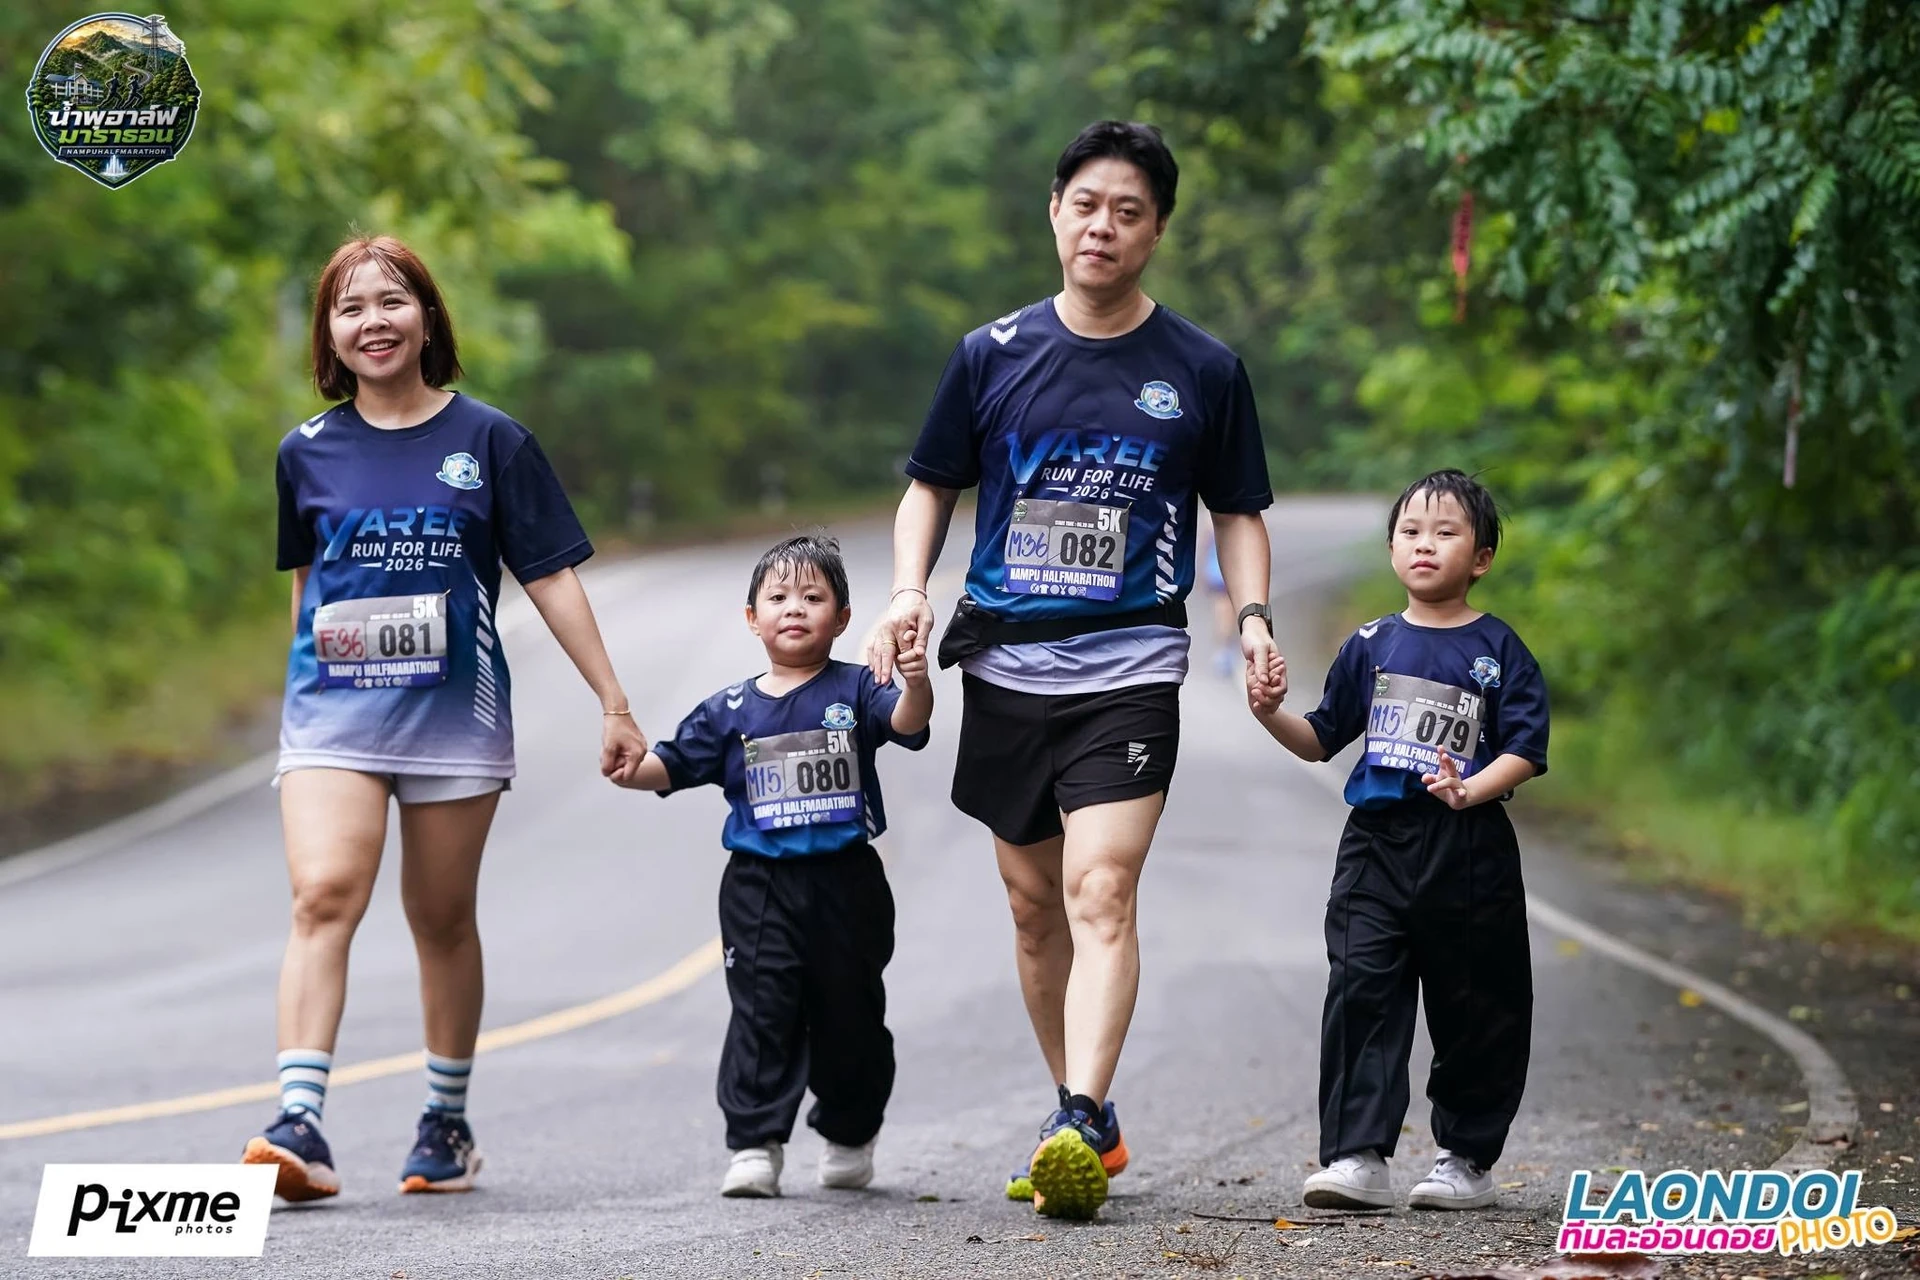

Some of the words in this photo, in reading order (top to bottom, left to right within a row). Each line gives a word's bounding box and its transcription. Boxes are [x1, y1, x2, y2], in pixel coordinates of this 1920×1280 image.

[1041, 467, 1077, 482] RUN
[1081, 469, 1114, 485] FOR
[1119, 472, 1154, 492] LIFE
[1071, 485, 1111, 500] 2026
[1097, 507, 1122, 533] 5K
[351, 542, 386, 558] RUN
[391, 541, 425, 557] FOR
[430, 541, 462, 558] LIFE
[1008, 530, 1049, 558] M36
[1060, 532, 1116, 569] 082
[384, 558, 425, 571] 2026
[1010, 567, 1040, 581] NAMPU
[1042, 569, 1116, 588] HALFMARATHON
[412, 596, 438, 619] 5K
[319, 628, 365, 658] F36
[379, 622, 431, 657] 081
[328, 664, 362, 677] NAMPU
[364, 660, 440, 676] HALFMARATHON
[1456, 692, 1480, 720] 5K
[1370, 704, 1404, 736] M15
[1416, 710, 1469, 753] 079
[826, 731, 850, 754] 5K
[747, 765, 781, 799] M15
[796, 758, 850, 794] 080
[783, 795, 856, 813] HALFMARATHON
